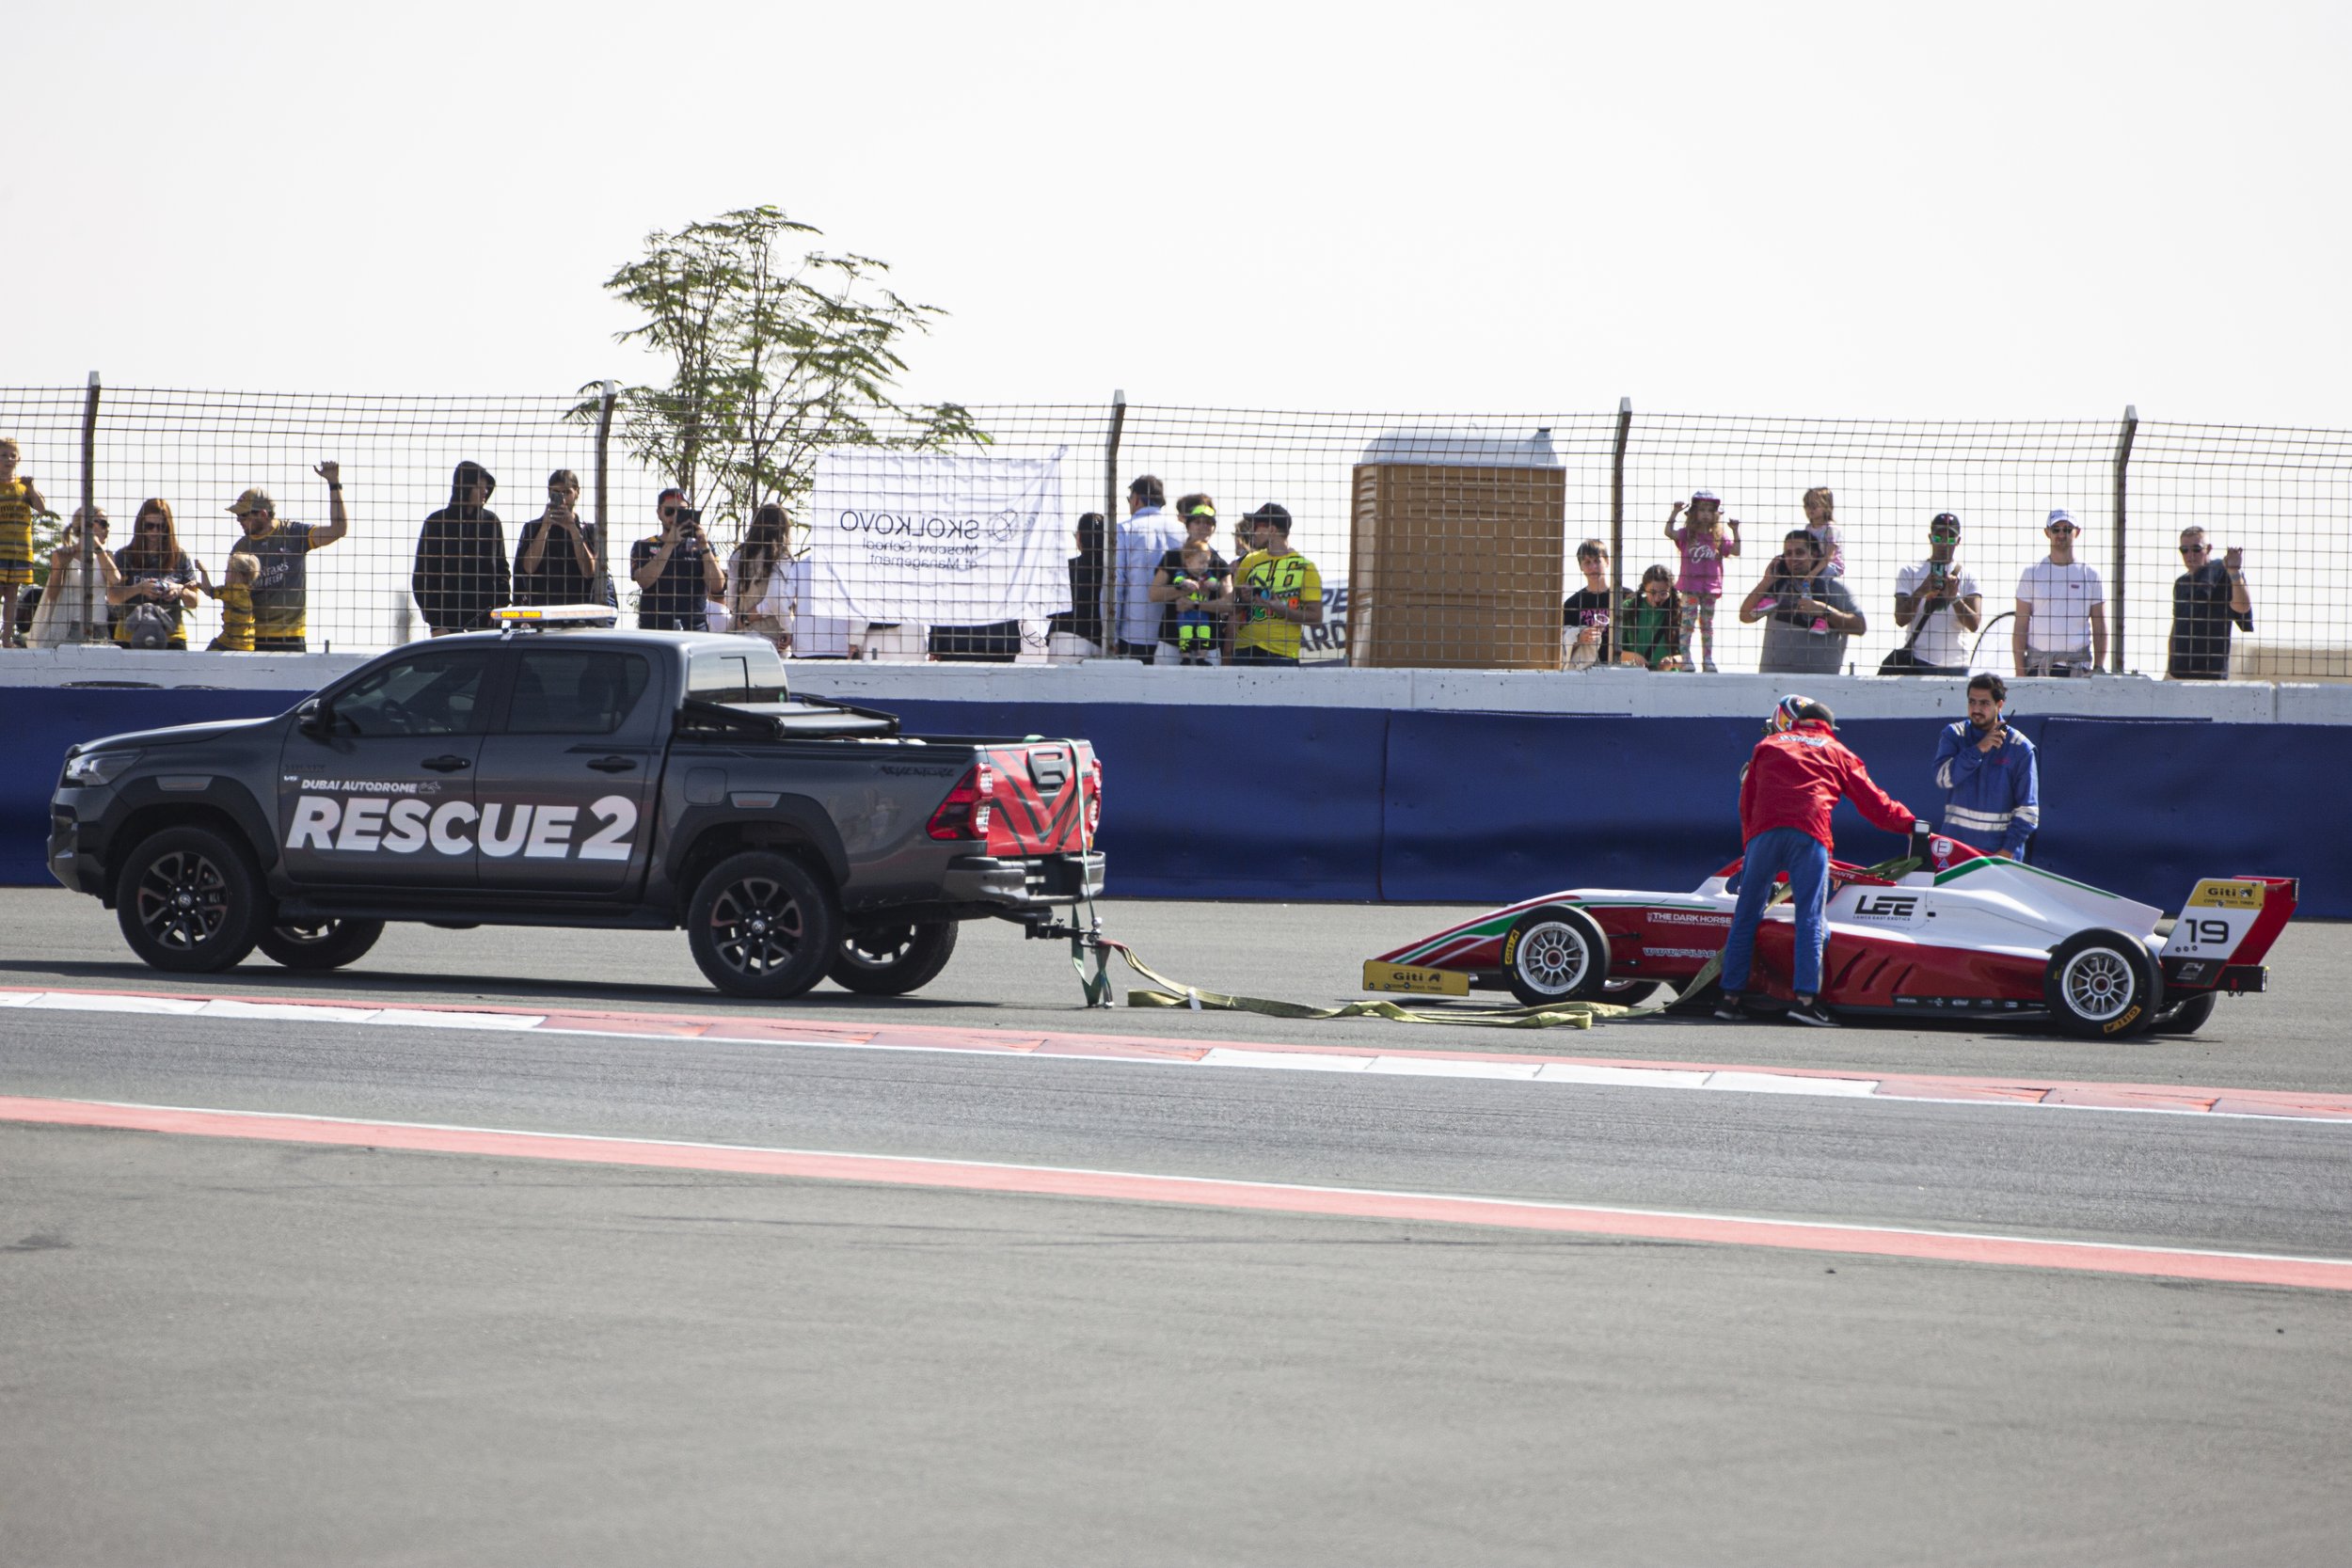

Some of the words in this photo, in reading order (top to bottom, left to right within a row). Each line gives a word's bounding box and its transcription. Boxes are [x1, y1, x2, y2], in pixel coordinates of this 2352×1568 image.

[301, 779, 340, 790] DUBAI
[342, 782, 418, 794] AUTODROME
[285, 796, 579, 858] RESCUE
[578, 795, 638, 861] 2
[2207, 887, 2236, 897] Giti
[1854, 895, 1918, 917] LEE
[1653, 911, 1673, 921] THE
[1673, 913, 1699, 923] DARK
[1700, 915, 1732, 925] HORSE
[2185, 918, 2230, 944] 19
[1392, 971, 1423, 982] Giti
